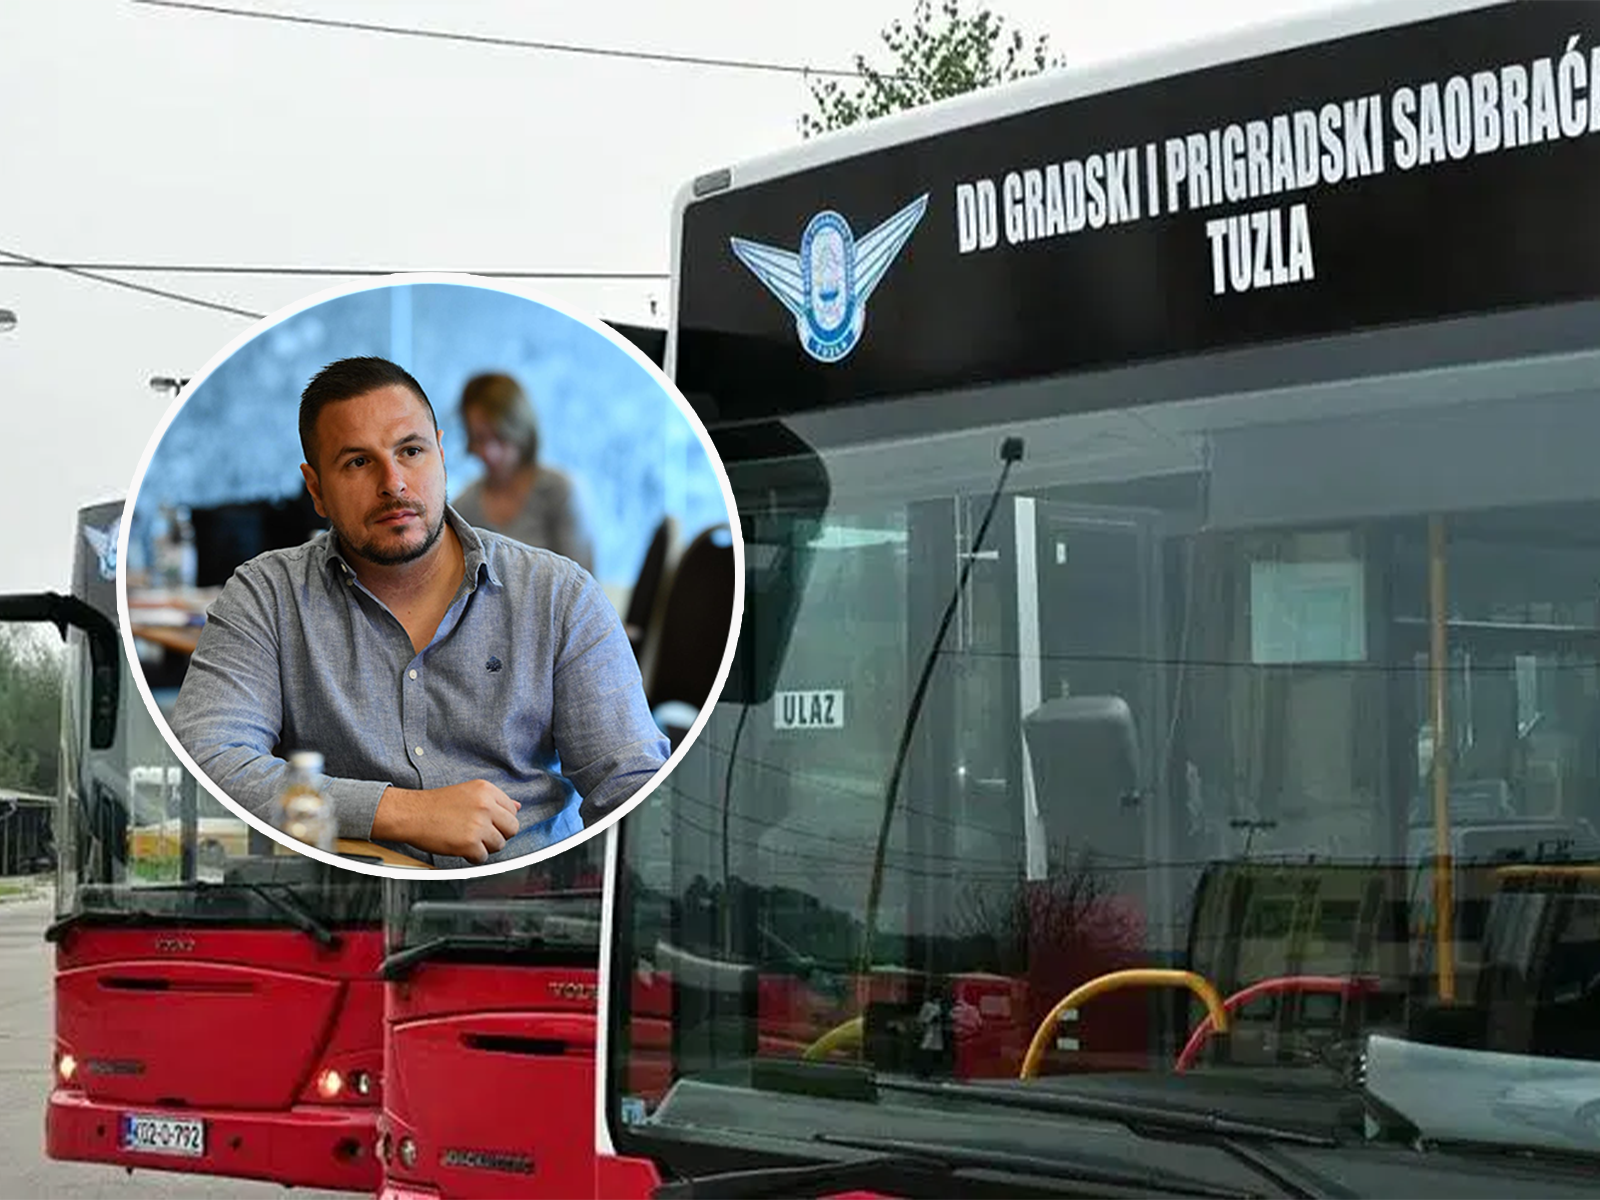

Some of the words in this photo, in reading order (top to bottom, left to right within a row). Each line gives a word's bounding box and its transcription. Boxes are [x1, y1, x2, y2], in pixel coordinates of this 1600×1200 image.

[956, 179, 999, 254] DD
[1003, 147, 1141, 245] GRADSKI
[1146, 143, 1160, 217] I
[1165, 94, 1385, 213] PRIGRADSKI
[1206, 203, 1315, 295] TUZLA
[783, 694, 835, 725] ULAZ
